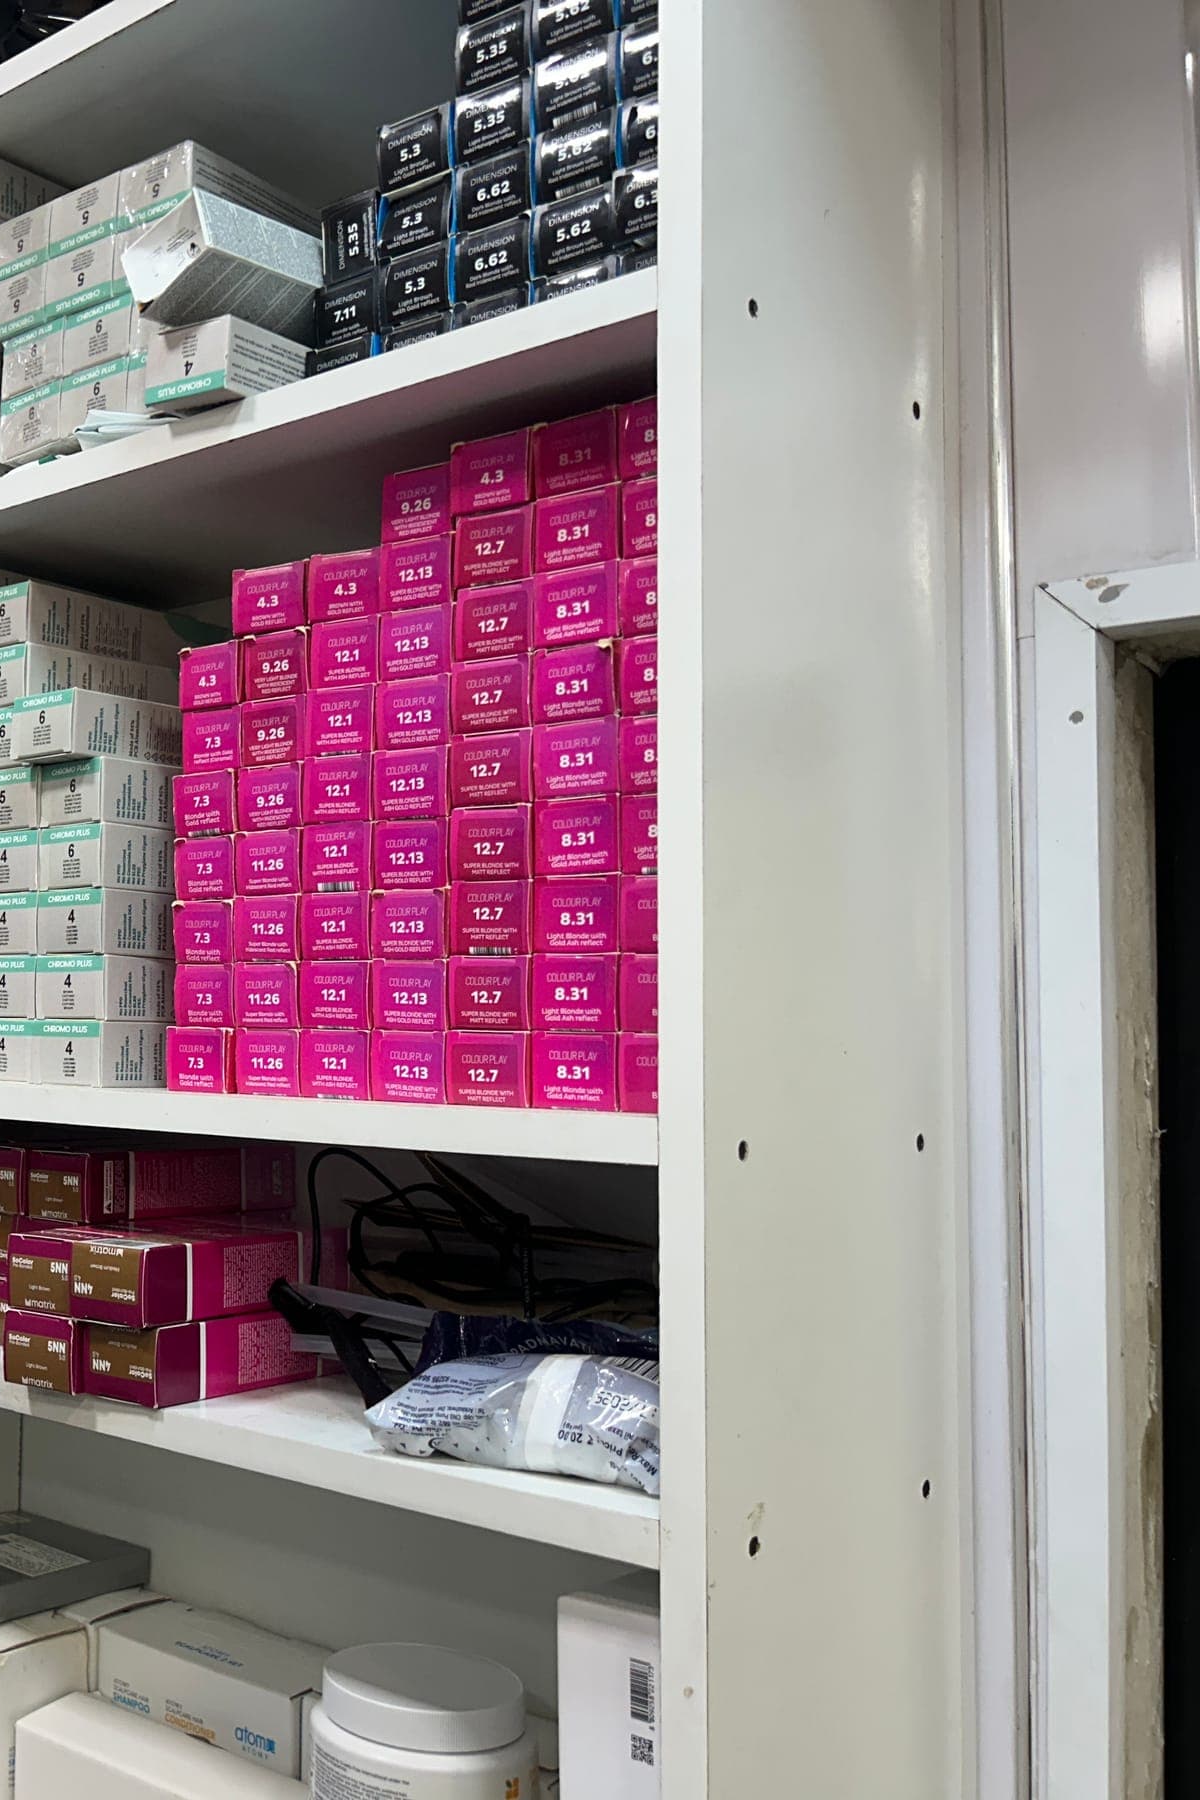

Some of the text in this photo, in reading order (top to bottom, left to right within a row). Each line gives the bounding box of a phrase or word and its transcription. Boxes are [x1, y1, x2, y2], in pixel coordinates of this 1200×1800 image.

[468, 23, 516, 49] DIMENSION
[476, 40, 507, 64] 5.35
[473, 111, 505, 133] 5.35
[388, 125, 432, 150] DIMENSION
[400, 144, 421, 162] 5.3
[394, 159, 428, 176] Light Brown
[470, 165, 517, 186] DIMENSION
[476, 181, 510, 202] 6.62
[82, 210, 89, 225] 5
[402, 212, 423, 228] 5.3
[549, 202, 599, 226] DIMENSION
[60, 226, 104, 249] CHROMO PLUS
[556, 220, 591, 242] 5.62
[348, 223, 359, 257] 5.35
[468, 234, 515, 255] DIMENSION
[474, 251, 508, 271] 6.62
[394, 260, 437, 280] DIMENSION
[404, 278, 425, 293] 5.3
[325, 289, 366, 309] DIMENSION
[76, 300, 120, 321] CHROMO PLUS
[333, 306, 357, 323] 7.11
[96, 319, 102, 333] 6
[185, 361, 192, 375] 4
[157, 378, 211, 398] CHROMO PLUS
[559, 448, 592, 466] 8.31
[480, 471, 504, 485] 4.3
[401, 499, 432, 513] 9.26
[557, 525, 590, 542] 8.31
[475, 541, 505, 556] 12.7
[399, 566, 433, 582] 12.13
[2, 587, 17, 598] PLUS
[334, 584, 357, 595] 4.3
[257, 596, 278, 608] 4.3
[0, 604, 5, 616] 6
[394, 636, 430, 652] 12.13
[335, 650, 359, 662] 12.1
[262, 660, 289, 673] 9.26
[199, 675, 216, 687] 4.3
[555, 679, 588, 695] 8.31
[22, 694, 62, 708] CHROMO PLUS
[472, 691, 502, 705] 12.7
[39, 711, 45, 724] 6
[559, 752, 593, 768] 8.31
[470, 763, 500, 778] 12.7
[546, 771, 607, 785] Light Blonde with
[550, 781, 564, 789] Gold
[579, 777, 604, 786] reflect
[0, 791, 5, 804] 5
[325, 785, 350, 796] 12.1
[193, 795, 210, 807] 7.3
[257, 794, 284, 807] 9.26
[184, 810, 220, 821] Blonde with
[200, 816, 220, 824] reflect
[561, 832, 595, 847] 8.31
[323, 846, 347, 857] 12.1
[251, 859, 284, 871] 11.26
[48, 892, 90, 903] CHROMO PLUS
[68, 909, 75, 923] 4
[473, 908, 503, 921] 12.7
[47, 959, 92, 969] CHROMO PLUS
[64, 974, 71, 988] 4
[196, 993, 212, 1005] 7.3
[43, 1024, 88, 1033] CHROMO PLUS
[65, 1041, 72, 1055] 4
[188, 1058, 204, 1069] 7.3
[251, 1058, 283, 1069] 11.26
[322, 1058, 346, 1069] 12.1
[393, 1065, 429, 1079] 12.13
[468, 1069, 499, 1082] 12.7
[557, 1066, 590, 1079] 8.31
[63, 1176, 78, 1186] 5NN
[12, 1257, 34, 1265] SoColor
[50, 1262, 68, 1274] 5NN
[74, 1282, 93, 1295] 4NN
[31, 1300, 56, 1310] matrix
[9, 1334, 30, 1342] SoColor
[48, 1341, 66, 1354] 5NN
[93, 1359, 111, 1372] 4NN
[28, 1377, 53, 1389] matrix
[113, 1692, 150, 1714] SHAMPOO
[165, 1713, 216, 1739] CONDITIONER
